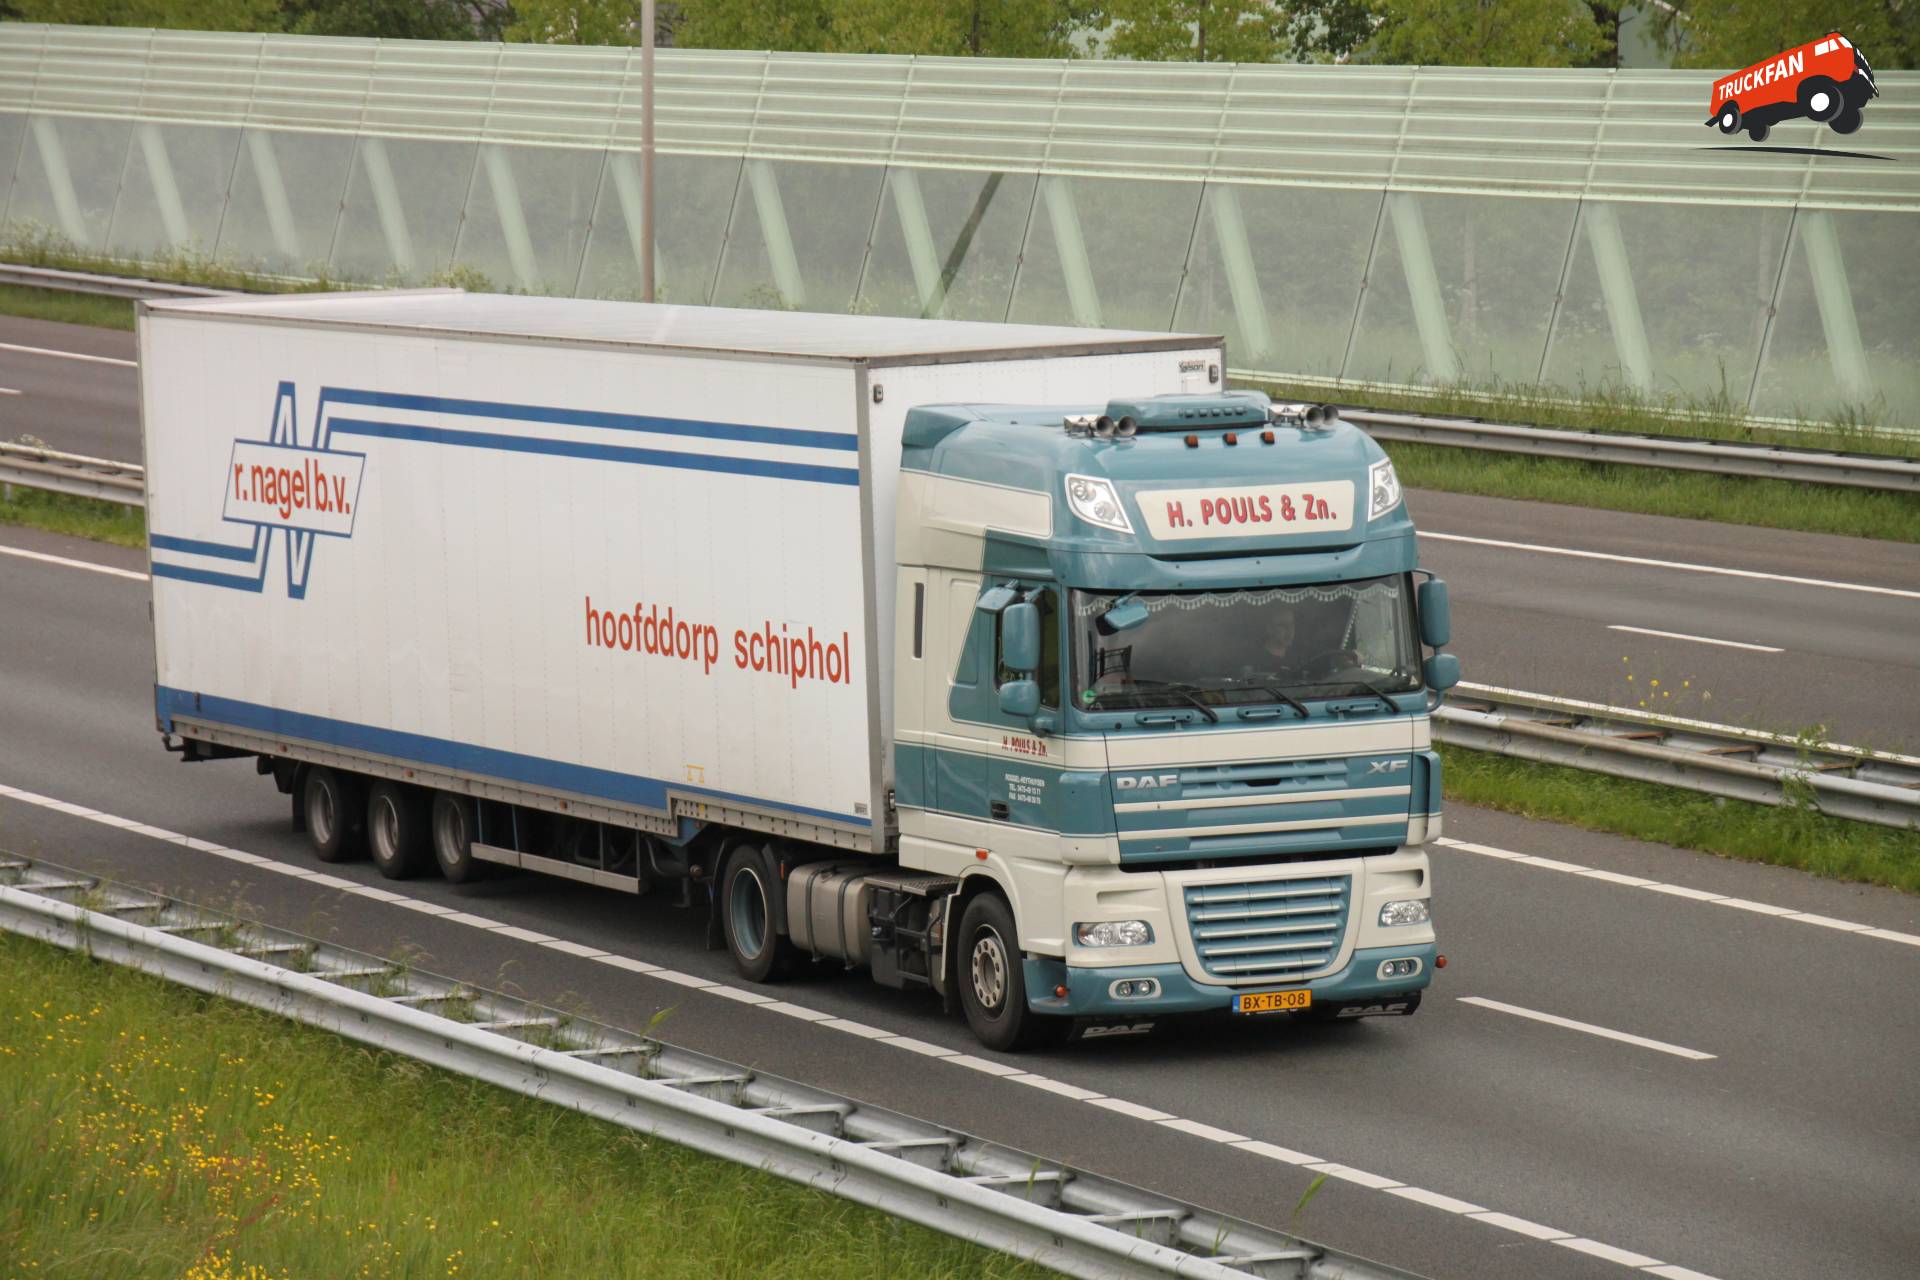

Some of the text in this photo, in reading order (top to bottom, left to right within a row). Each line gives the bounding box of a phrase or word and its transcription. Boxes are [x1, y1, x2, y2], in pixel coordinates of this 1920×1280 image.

[252, 458, 311, 519] nagel
[314, 459, 350, 514] b.v.
[1166, 493, 1337, 528] H. POULS & Zn.
[585, 596, 850, 689] hoofddorp schiphol
[1367, 759, 1409, 775] XF
[1116, 774, 1178, 790] DAF
[1243, 992, 1306, 1010] BX-TB-08
[1336, 1002, 1408, 1018] DAF
[1082, 1023, 1155, 1039] DAF
